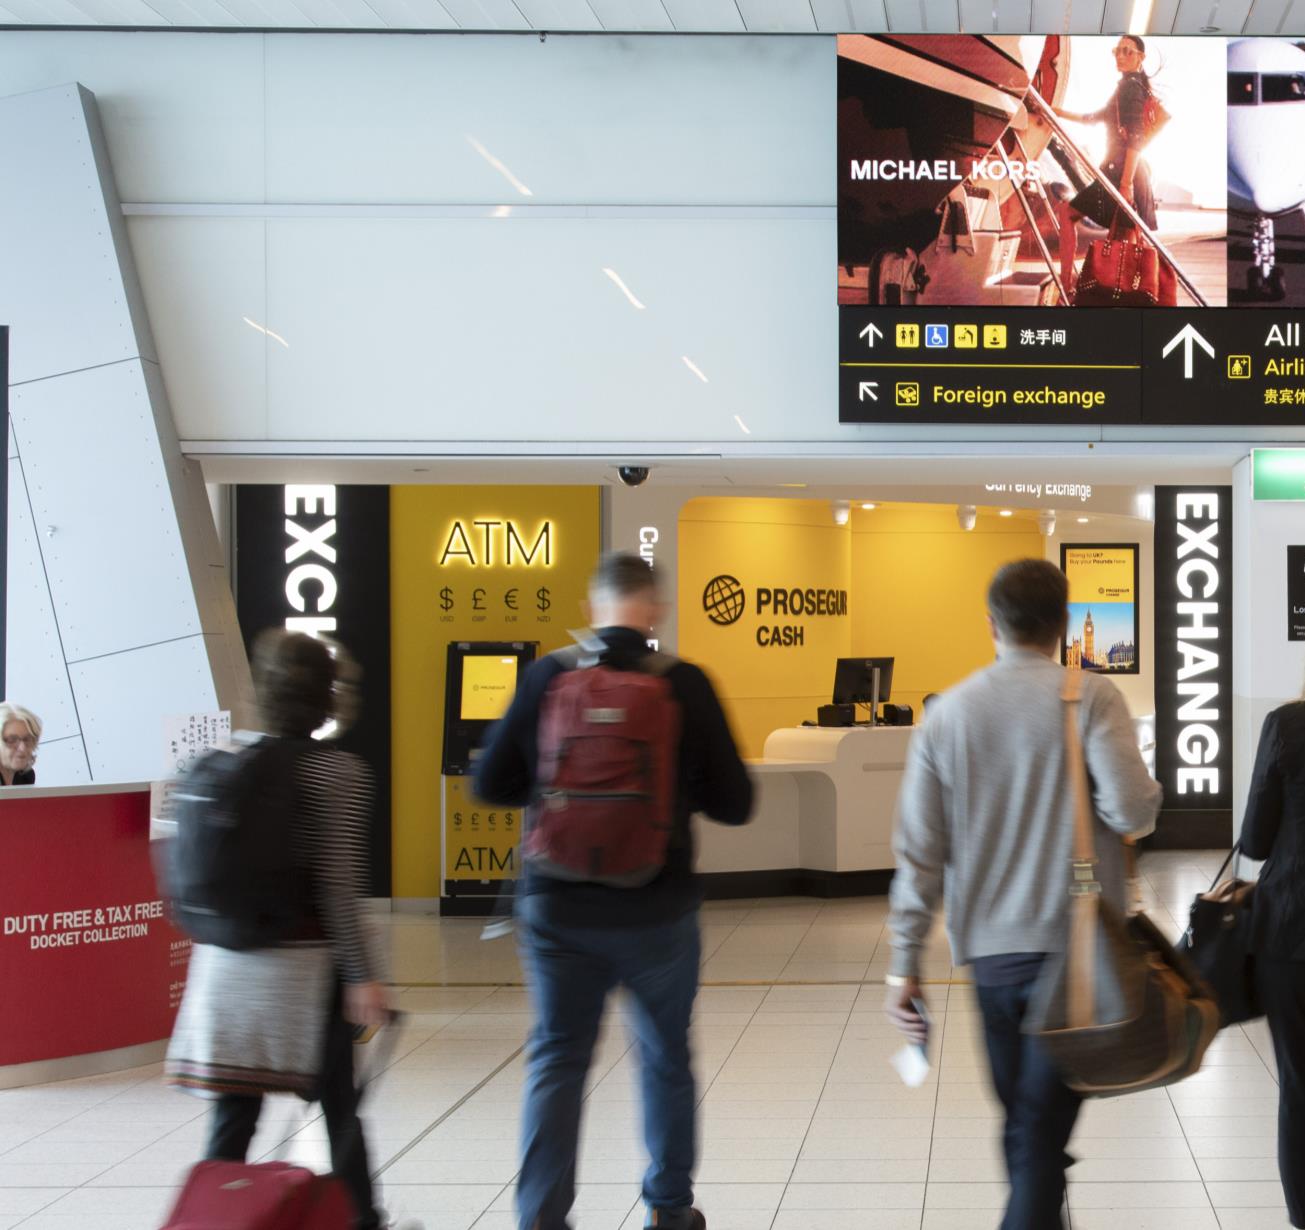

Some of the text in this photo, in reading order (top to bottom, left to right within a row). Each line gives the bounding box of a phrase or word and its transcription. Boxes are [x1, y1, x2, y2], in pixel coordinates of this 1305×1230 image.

[851, 160, 1041, 181] MICHAEL KORS
[1020, 329, 1066, 345] 洗手间
[1264, 323, 1300, 347] All
[933, 386, 1105, 409] Foreign exchange
[440, 520, 550, 565] ATM
[756, 588, 847, 616] PROSEGUR
[756, 626, 804, 646] CASH
[1176, 493, 1219, 794] EXCHANGE
[454, 847, 513, 871] ATM
[4, 900, 164, 935] DUTY FREE & TAX FREE
[30, 923, 148, 949] DOCKET COLLECTION
